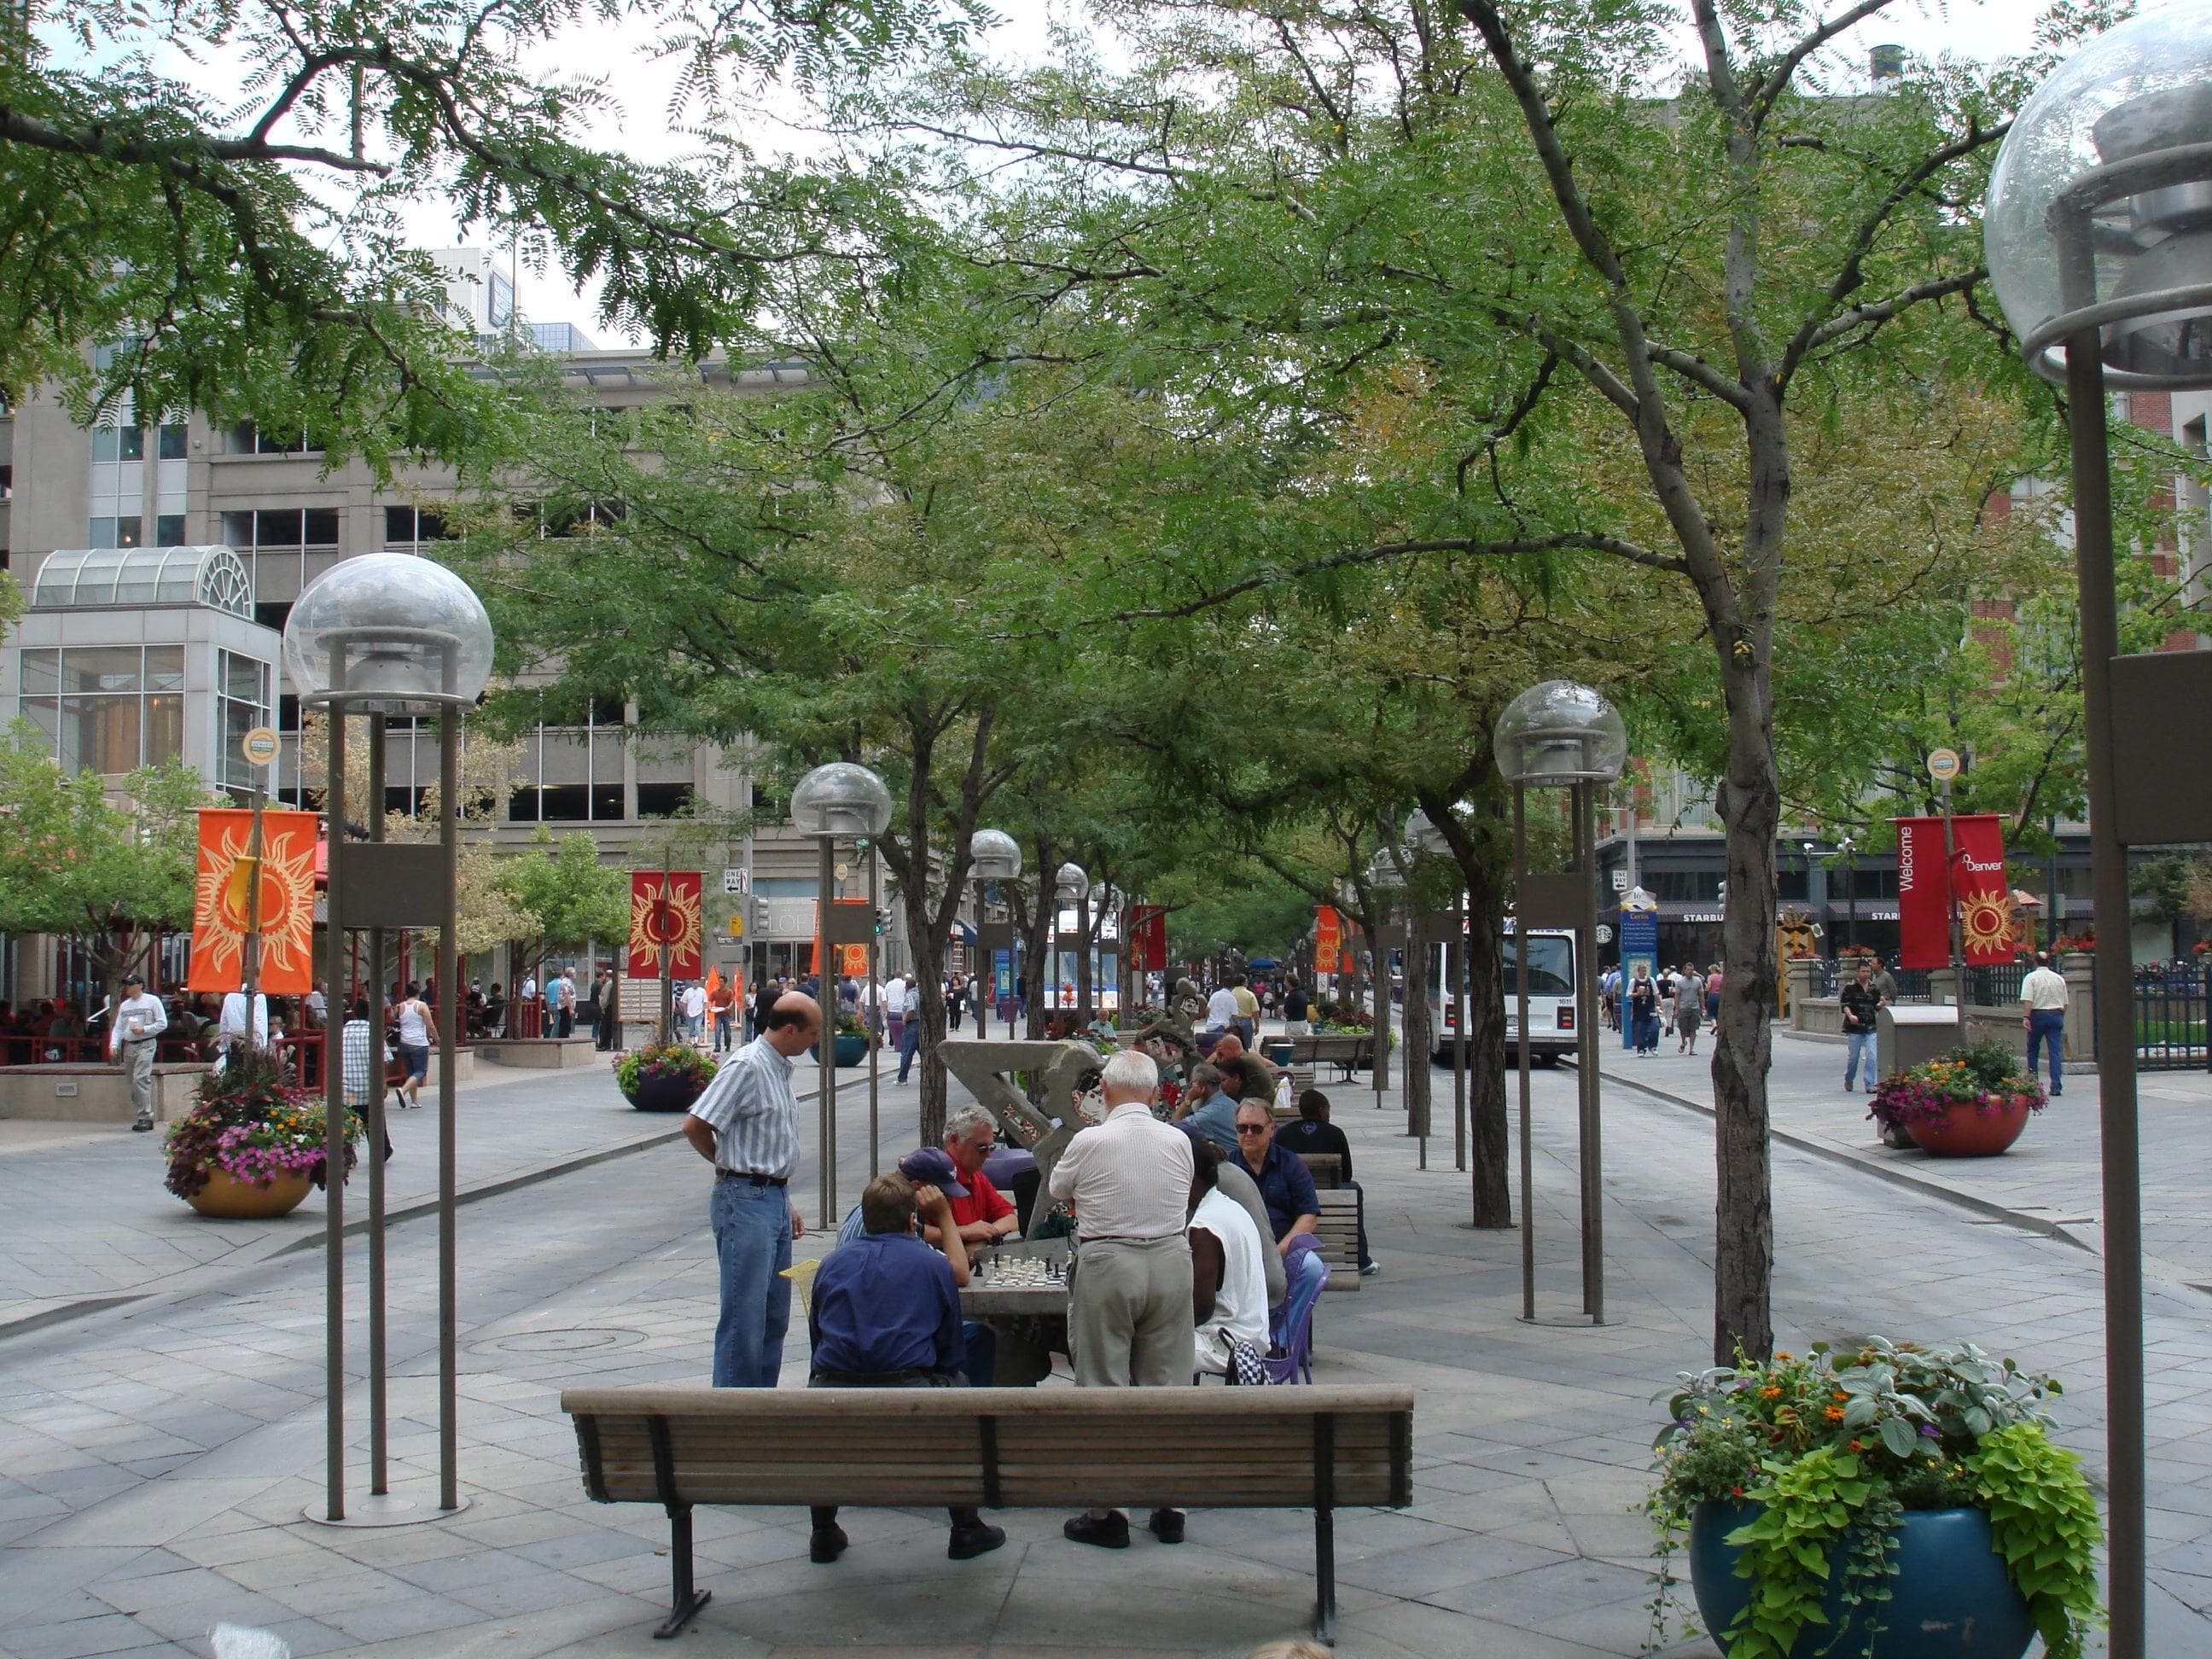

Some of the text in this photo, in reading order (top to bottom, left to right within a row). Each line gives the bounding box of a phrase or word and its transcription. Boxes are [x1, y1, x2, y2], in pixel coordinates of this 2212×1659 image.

[1899, 826, 1913, 893] Welcome
[1967, 861, 2003, 872] Denver
[1683, 913, 1724, 923] STARBU
